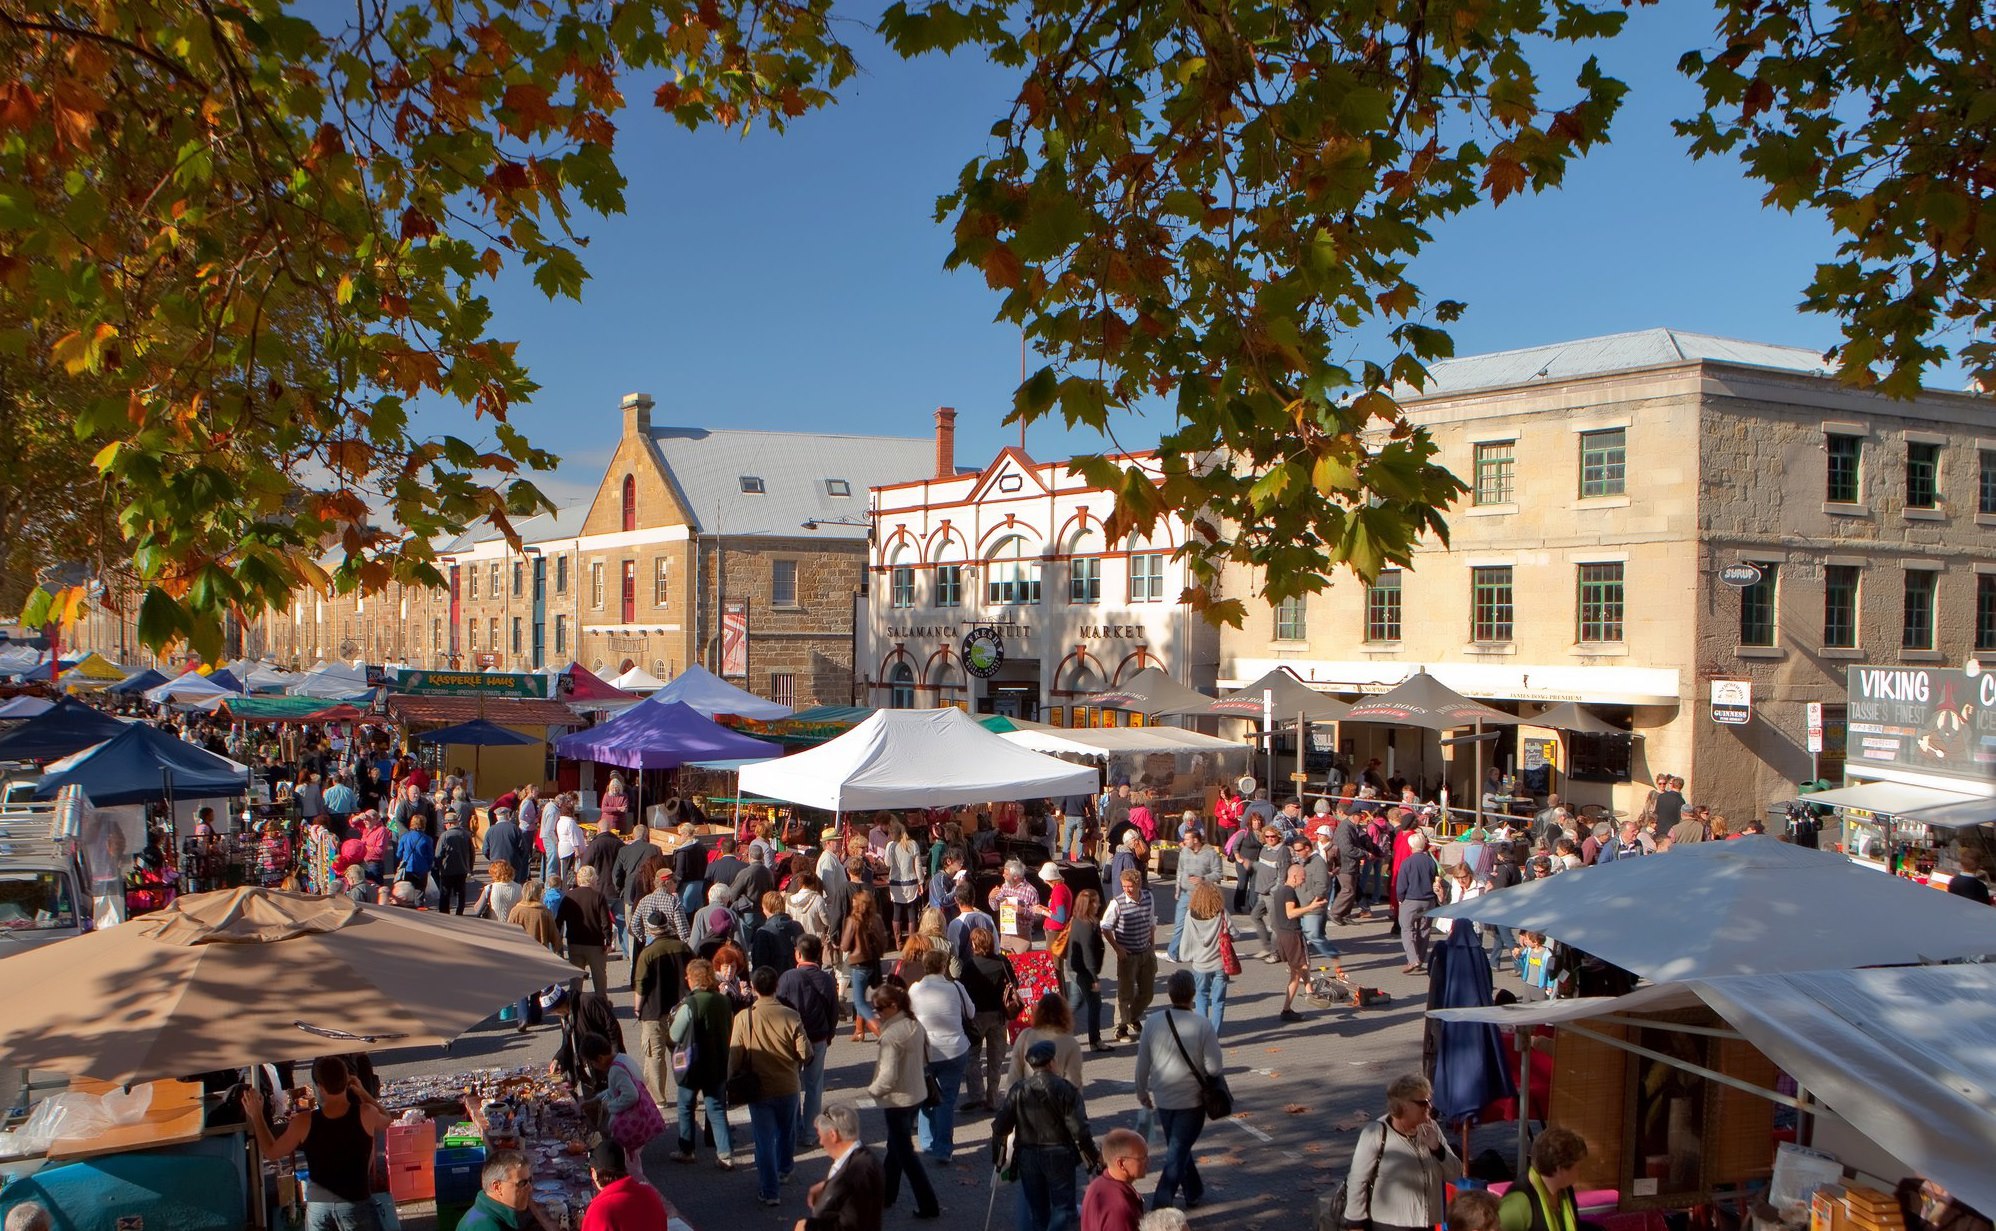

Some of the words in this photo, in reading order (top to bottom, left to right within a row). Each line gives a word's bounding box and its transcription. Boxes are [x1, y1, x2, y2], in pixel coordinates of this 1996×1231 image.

[1725, 568, 1754, 579] SYRUP
[887, 626, 959, 638] SALAMANCA
[1079, 625, 1145, 638] MARKET
[968, 629, 1000, 644] FRESH
[428, 674, 482, 687] KASPERLE
[486, 676, 515, 688] HAUS
[1860, 669, 1930, 702] VIKING
[1350, 703, 1392, 711] JAMES
[1851, 701, 1889, 721] TASSIE'S
[1895, 703, 1927, 724] FINEST
[1713, 709, 1748, 719] GUINNESS
